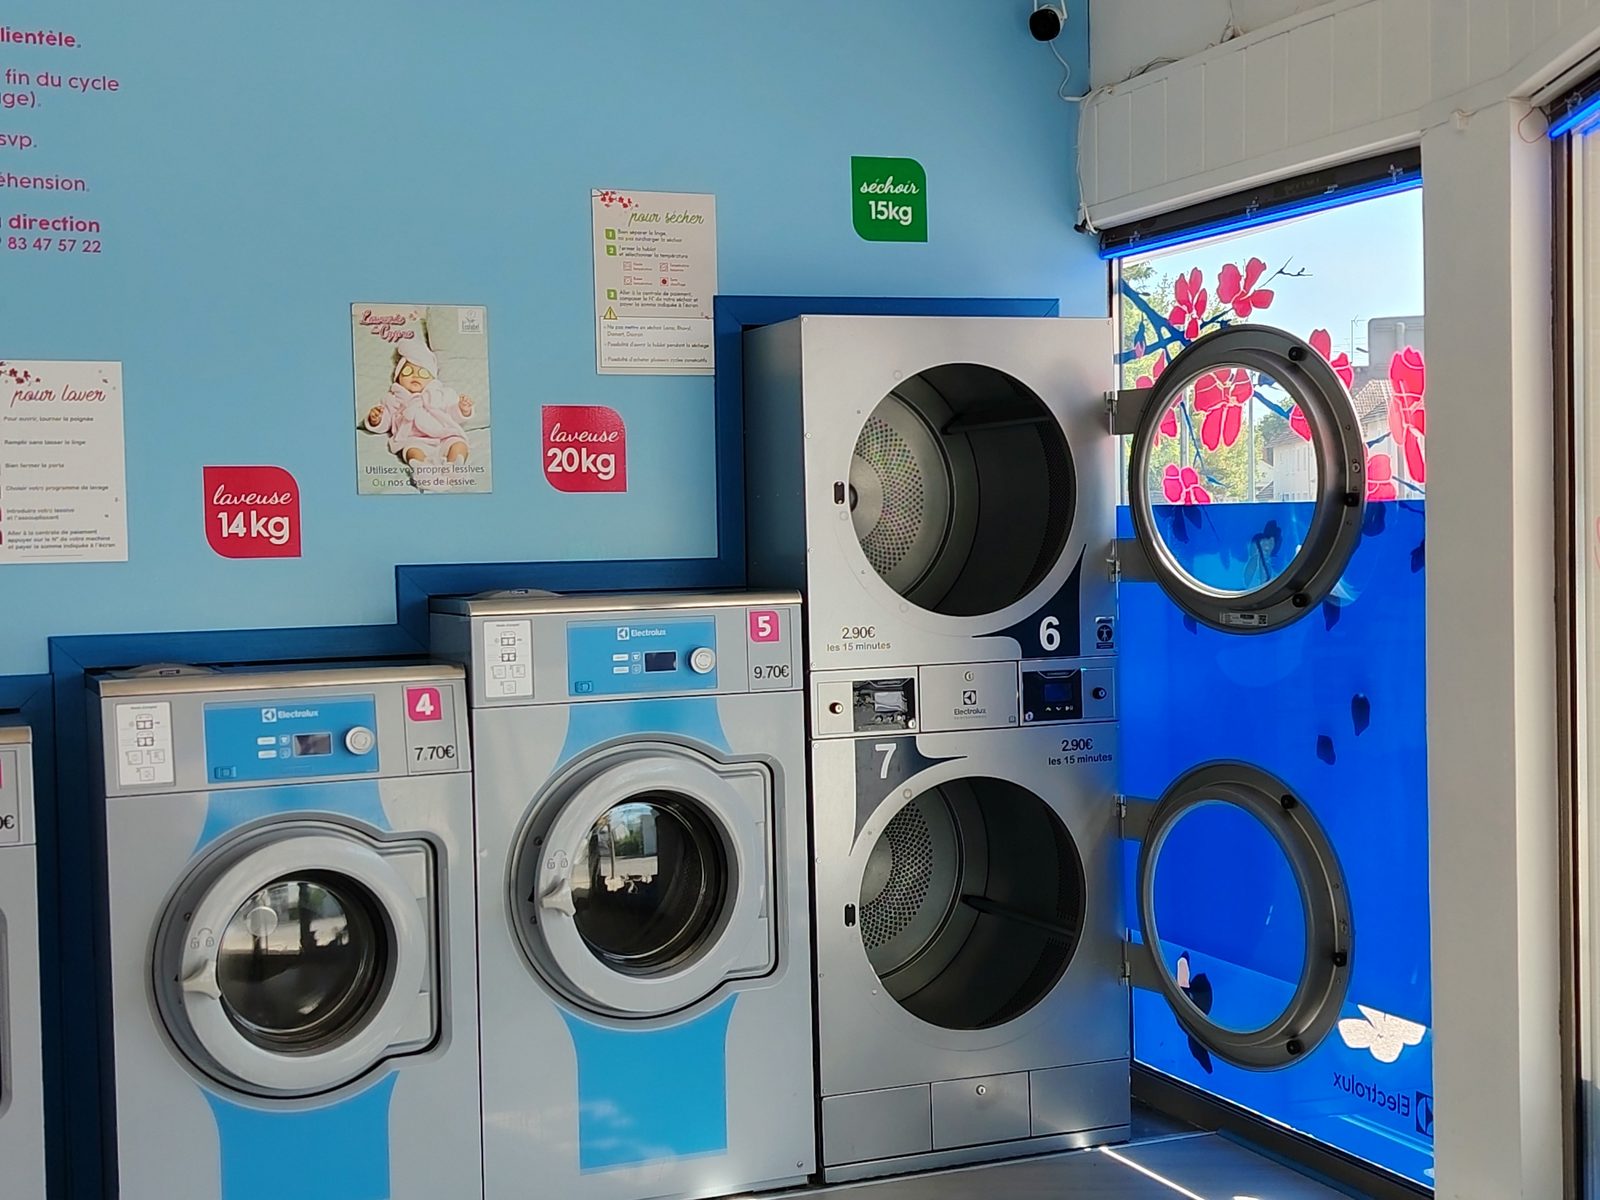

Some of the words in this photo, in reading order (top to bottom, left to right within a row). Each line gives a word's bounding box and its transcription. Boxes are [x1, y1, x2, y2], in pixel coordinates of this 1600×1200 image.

[5, 69, 30, 86] fin
[36, 72, 62, 88] du
[68, 75, 120, 93] cycle
[860, 176, 919, 194] séchoir
[628, 211, 661, 228] pour
[665, 209, 705, 224] sécher
[869, 200, 912, 226] 15kg
[8, 214, 101, 233] direction
[8, 237, 27, 250] 83
[32, 237, 52, 251] 47
[58, 239, 77, 252] 57
[82, 240, 102, 253] 22
[10, 390, 56, 408] pour
[61, 384, 106, 402] laver
[548, 424, 620, 444] laveuse
[365, 466, 398, 474] Utilisez
[416, 466, 450, 476] propres
[452, 465, 485, 473] lessives
[547, 448, 616, 480] 20kg
[372, 478, 386, 486] Ou
[433, 478, 445, 486] de
[446, 477, 477, 486] lessive.
[213, 484, 293, 506] laveuse
[217, 511, 290, 546] 14kg
[631, 628, 666, 637] Electrolux
[758, 615, 772, 637] 5
[842, 626, 876, 640] 2.90€
[1038, 616, 1061, 651] 6
[826, 643, 840, 652] les
[843, 642, 854, 651] 15
[855, 642, 891, 650] minutes
[754, 664, 790, 680] 9.70€
[415, 693, 434, 716] 4
[954, 708, 987, 716] Electrolux
[278, 709, 319, 720] Electrolux
[414, 745, 456, 762] 7.70€
[1061, 738, 1094, 752] 2.90€
[874, 743, 897, 779] 7
[1048, 756, 1061, 766] les
[1064, 756, 1075, 764] 15
[1076, 753, 1112, 763] minutes
